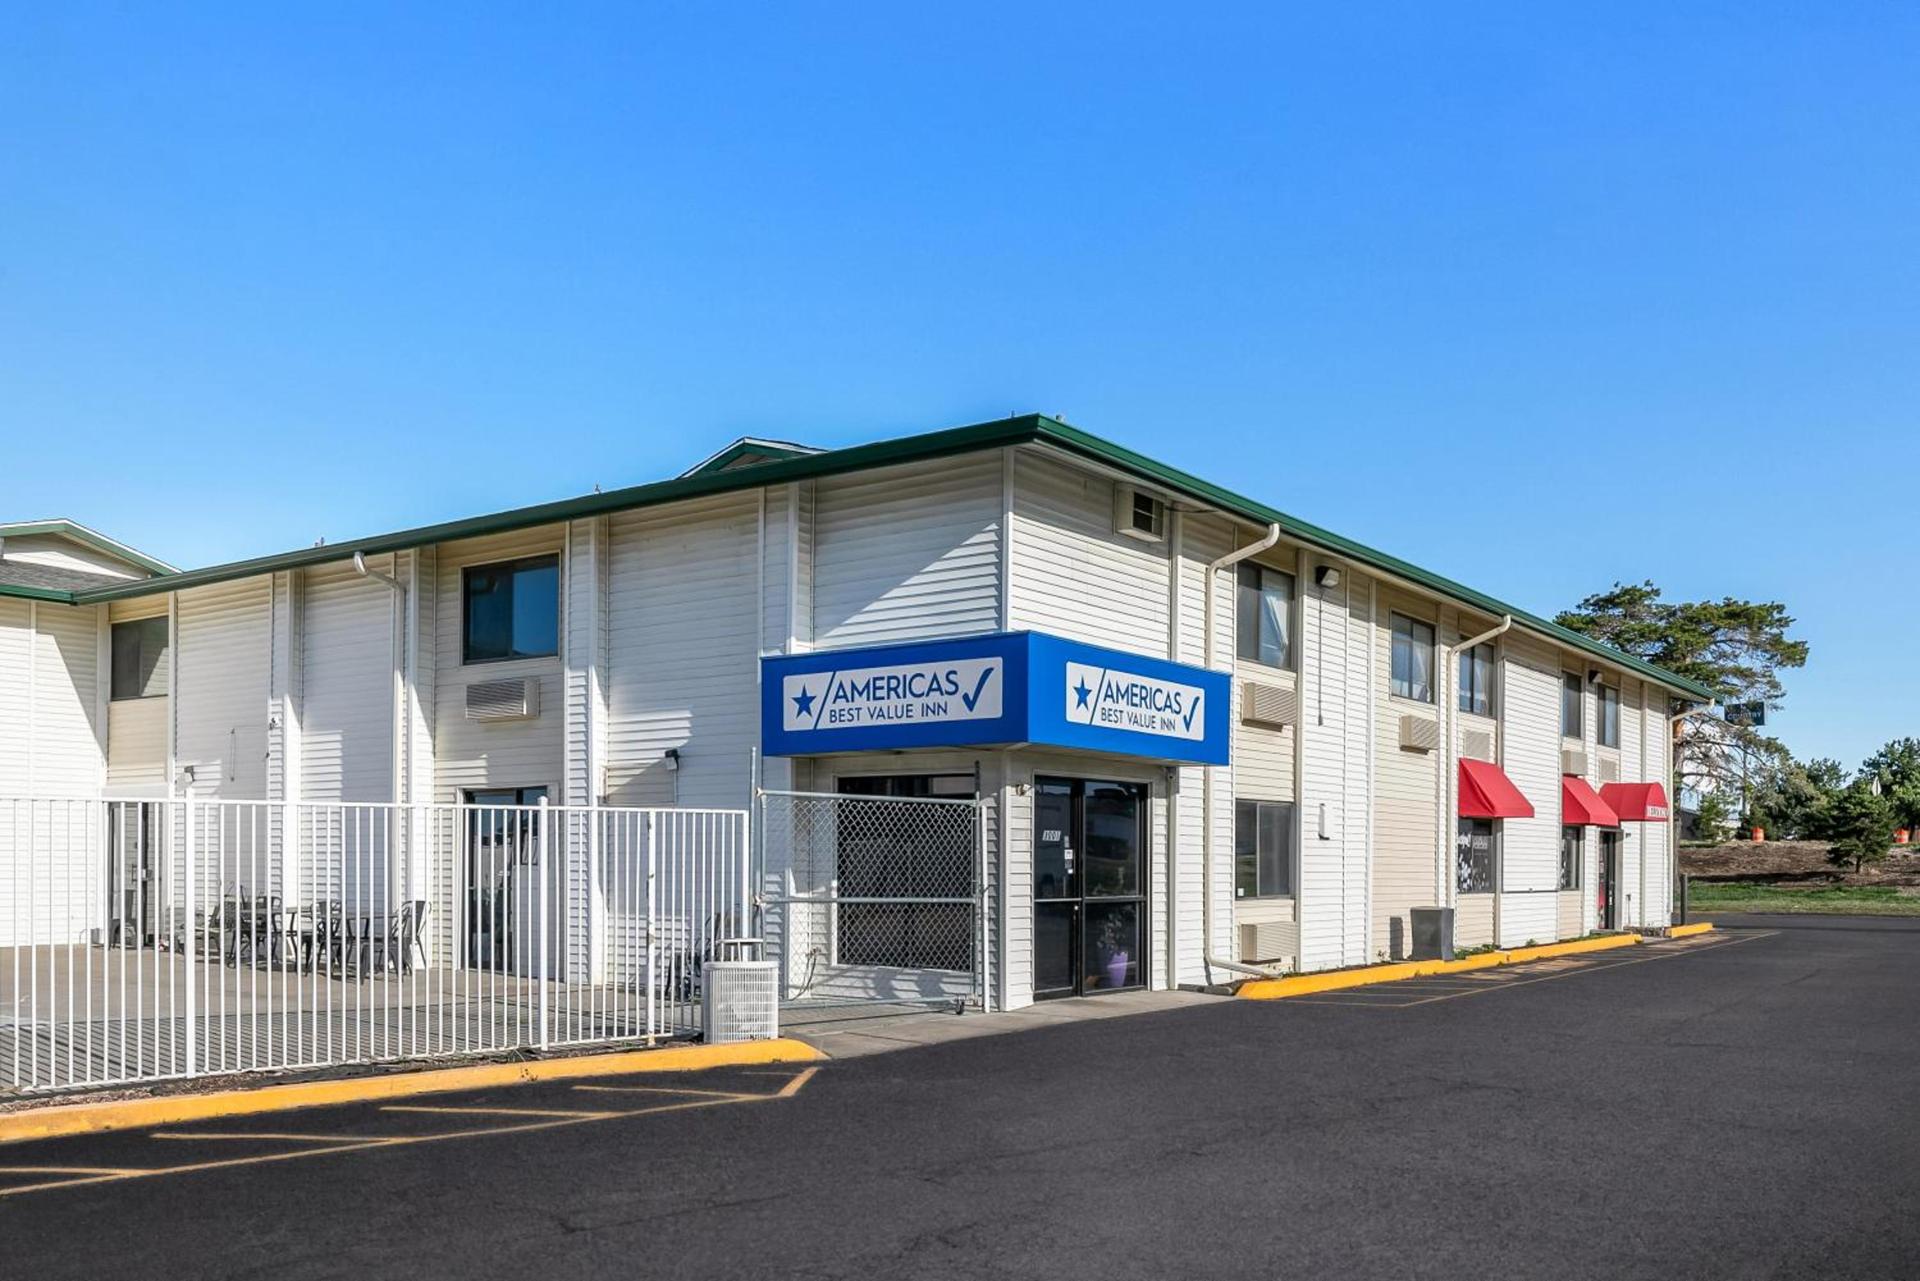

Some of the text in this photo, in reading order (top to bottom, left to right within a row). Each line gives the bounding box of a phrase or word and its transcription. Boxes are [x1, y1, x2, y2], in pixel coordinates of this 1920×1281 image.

[832, 670, 960, 704] AMERICAS
[1103, 679, 1182, 715] AMERICAS
[829, 701, 948, 723] BEST VALUE INN
[1101, 707, 1176, 732] BEST VALUE INN
